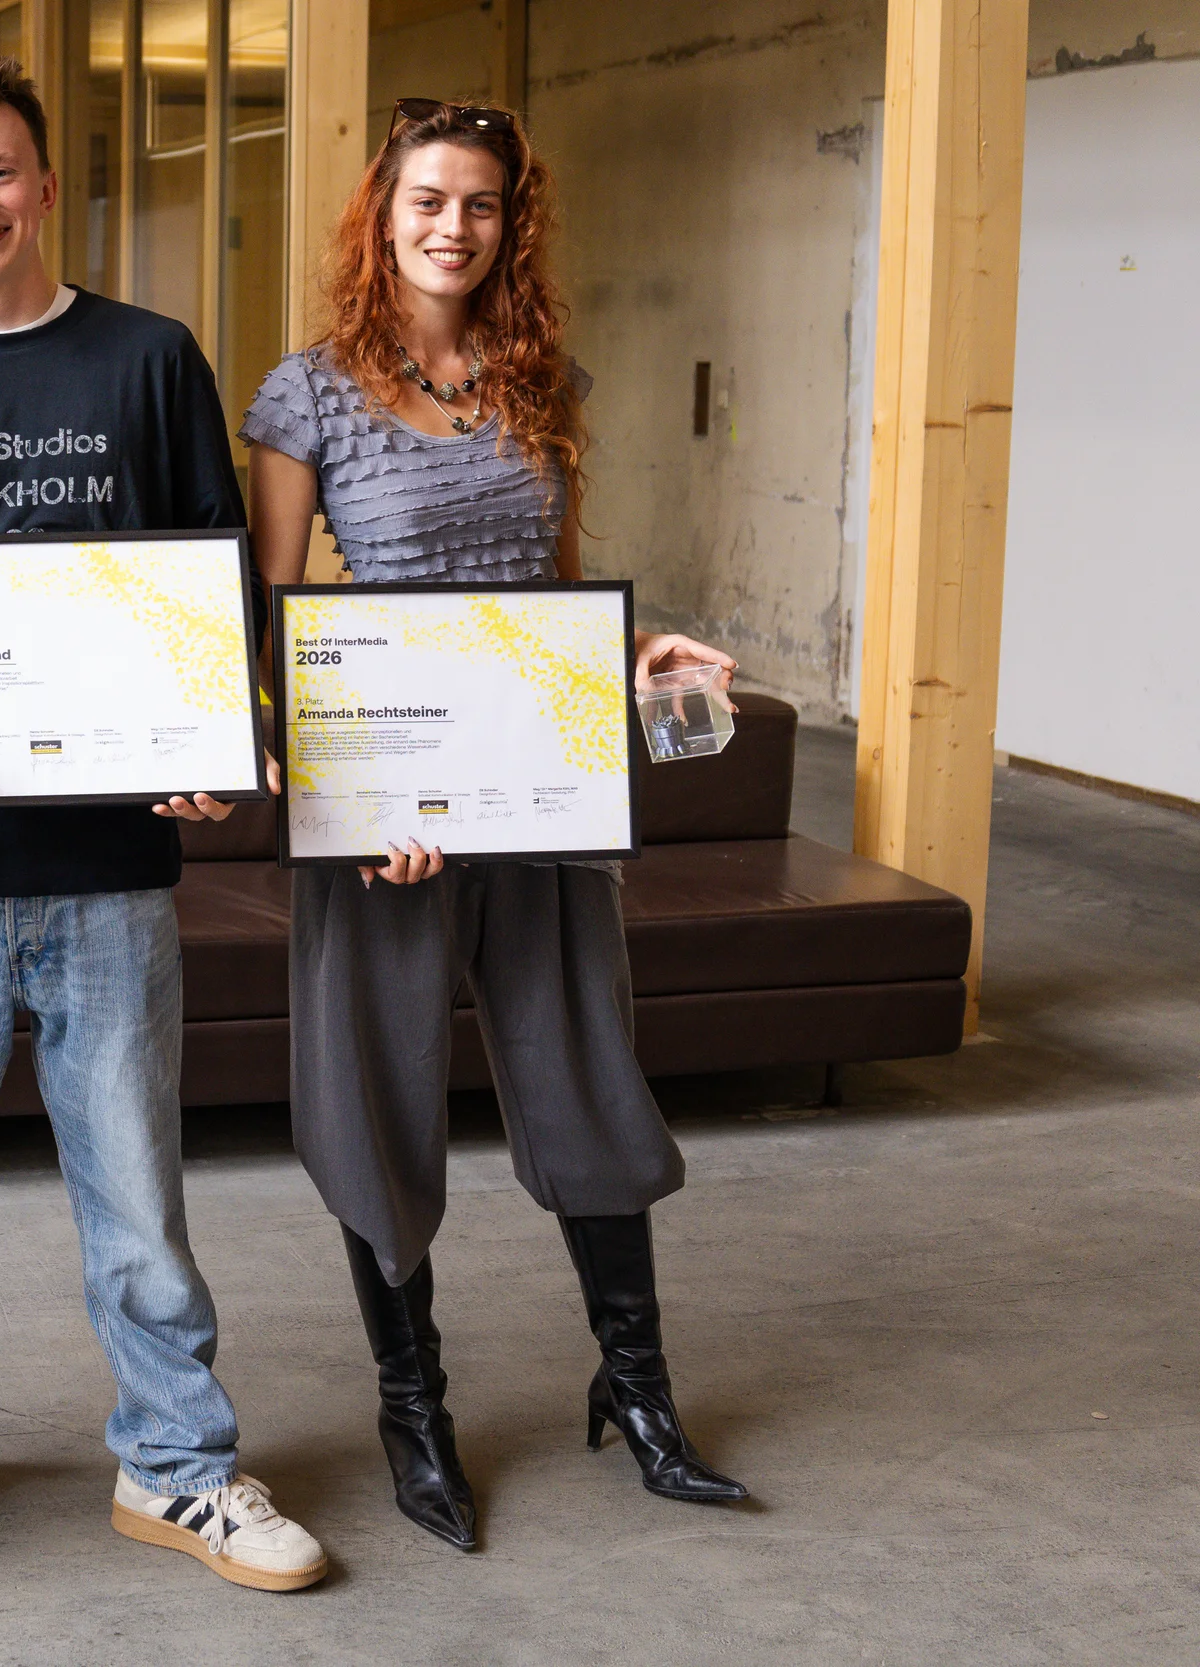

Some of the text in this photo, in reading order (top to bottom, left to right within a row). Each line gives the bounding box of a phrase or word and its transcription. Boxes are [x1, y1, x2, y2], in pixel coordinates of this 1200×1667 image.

[295, 637, 388, 647] Best Of InterMedia
[295, 650, 342, 666] 2026
[296, 698, 324, 706] 3. Platz
[297, 705, 448, 720] Amanda Rechtsteiner
